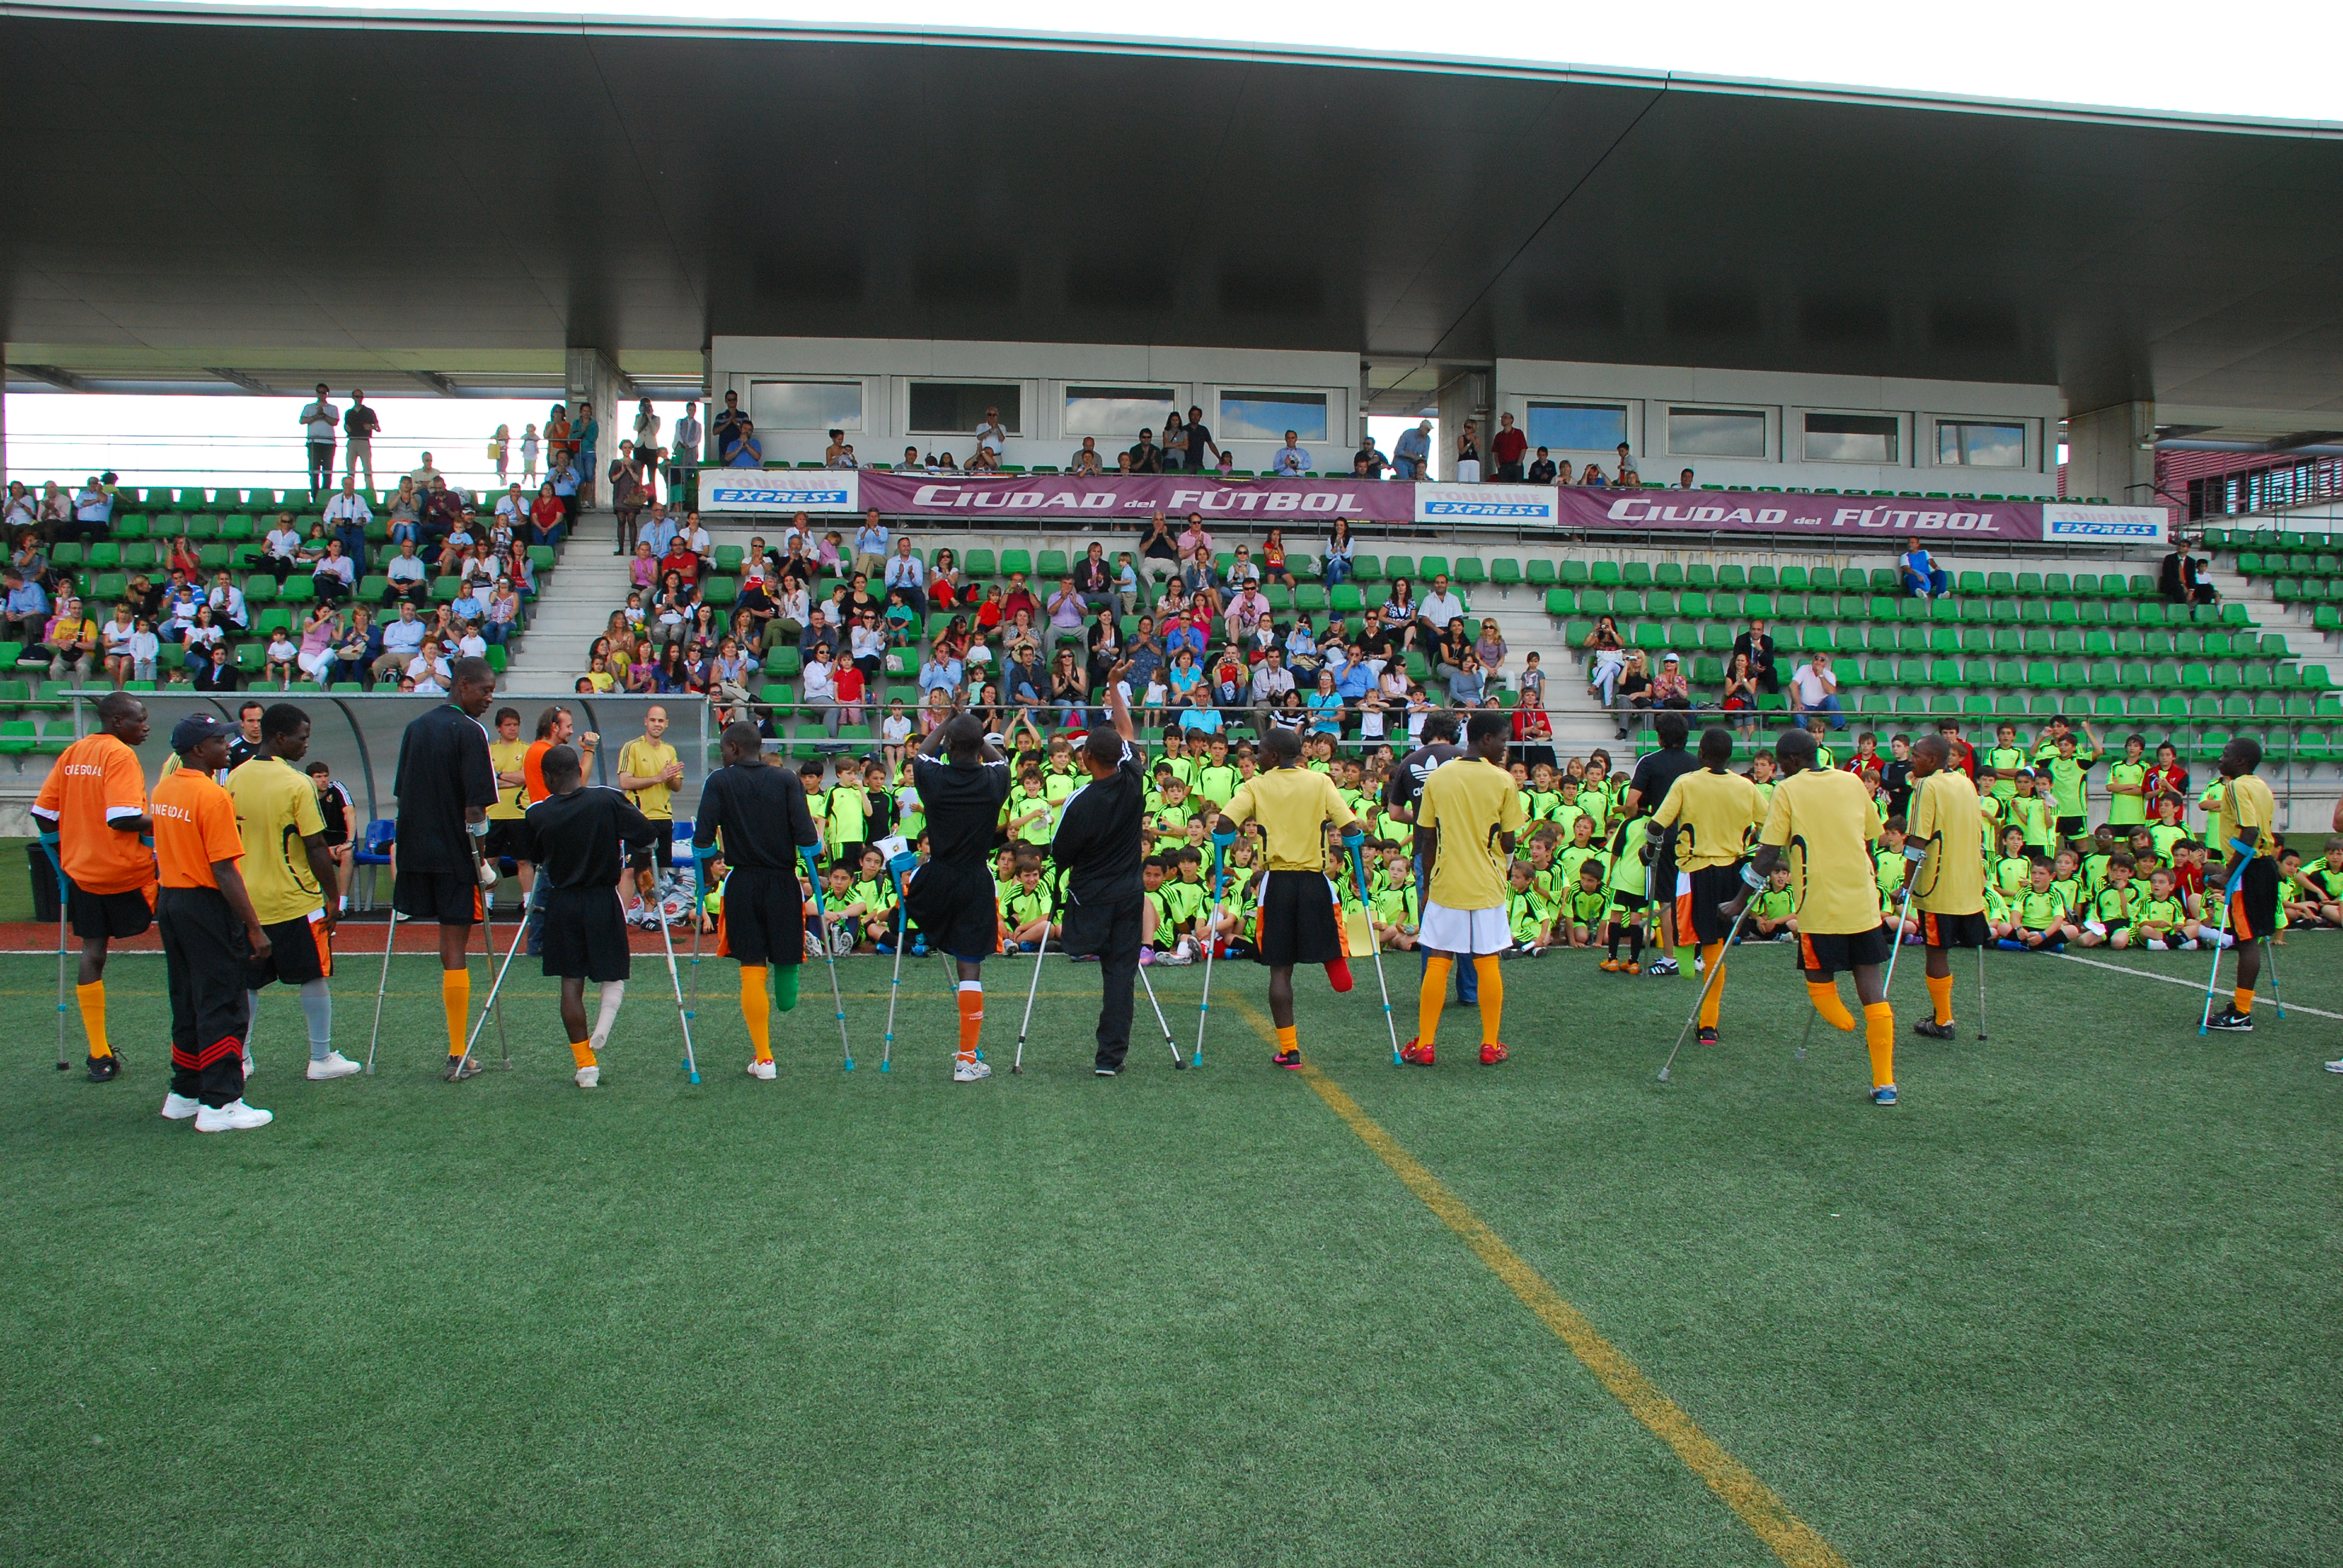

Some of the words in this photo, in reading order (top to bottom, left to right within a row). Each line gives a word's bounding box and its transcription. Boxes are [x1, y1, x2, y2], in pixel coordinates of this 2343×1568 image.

[718, 477, 842, 489] TOURLINE
[720, 491, 841, 503] EXPRESS
[1124, 500, 1156, 508] del
[1168, 488, 1363, 512] FÚTBOL
[1429, 491, 1542, 504] TOURLINE
[1431, 503, 1543, 515] EXPRESS
[1831, 505, 2000, 531] FÚTBOL
[2056, 512, 2151, 524] TOURLINE
[2057, 523, 2151, 534] EXPRESS
